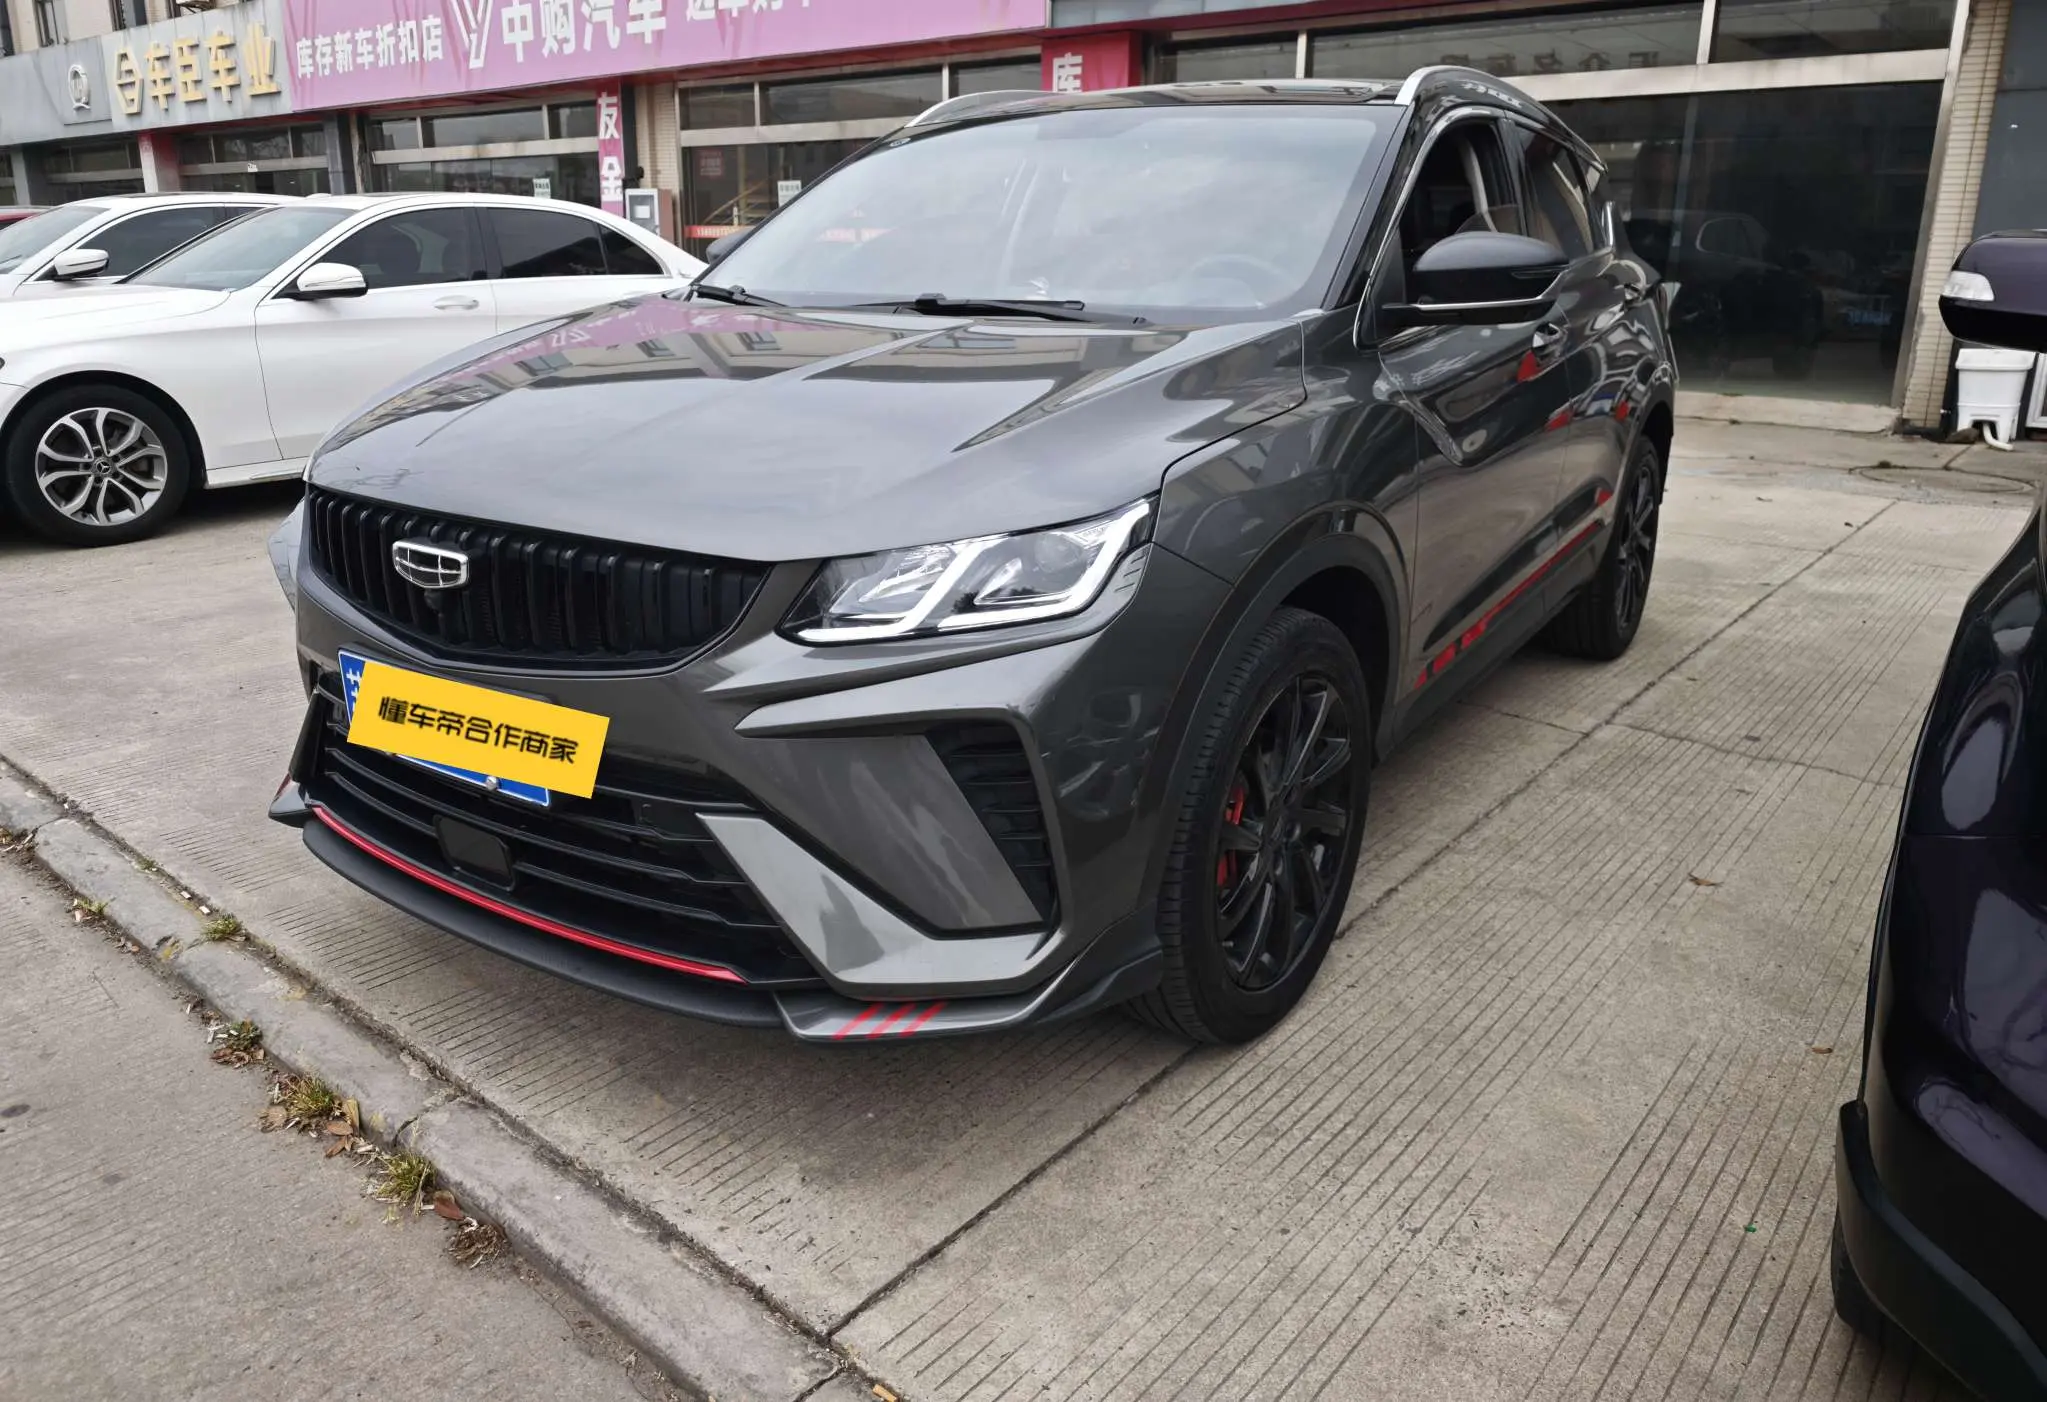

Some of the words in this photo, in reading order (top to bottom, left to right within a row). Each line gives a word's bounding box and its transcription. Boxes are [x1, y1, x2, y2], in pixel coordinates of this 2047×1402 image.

[296, 14, 444, 79] 库存新车折扣店
[501, 0, 666, 63] 中购汽车
